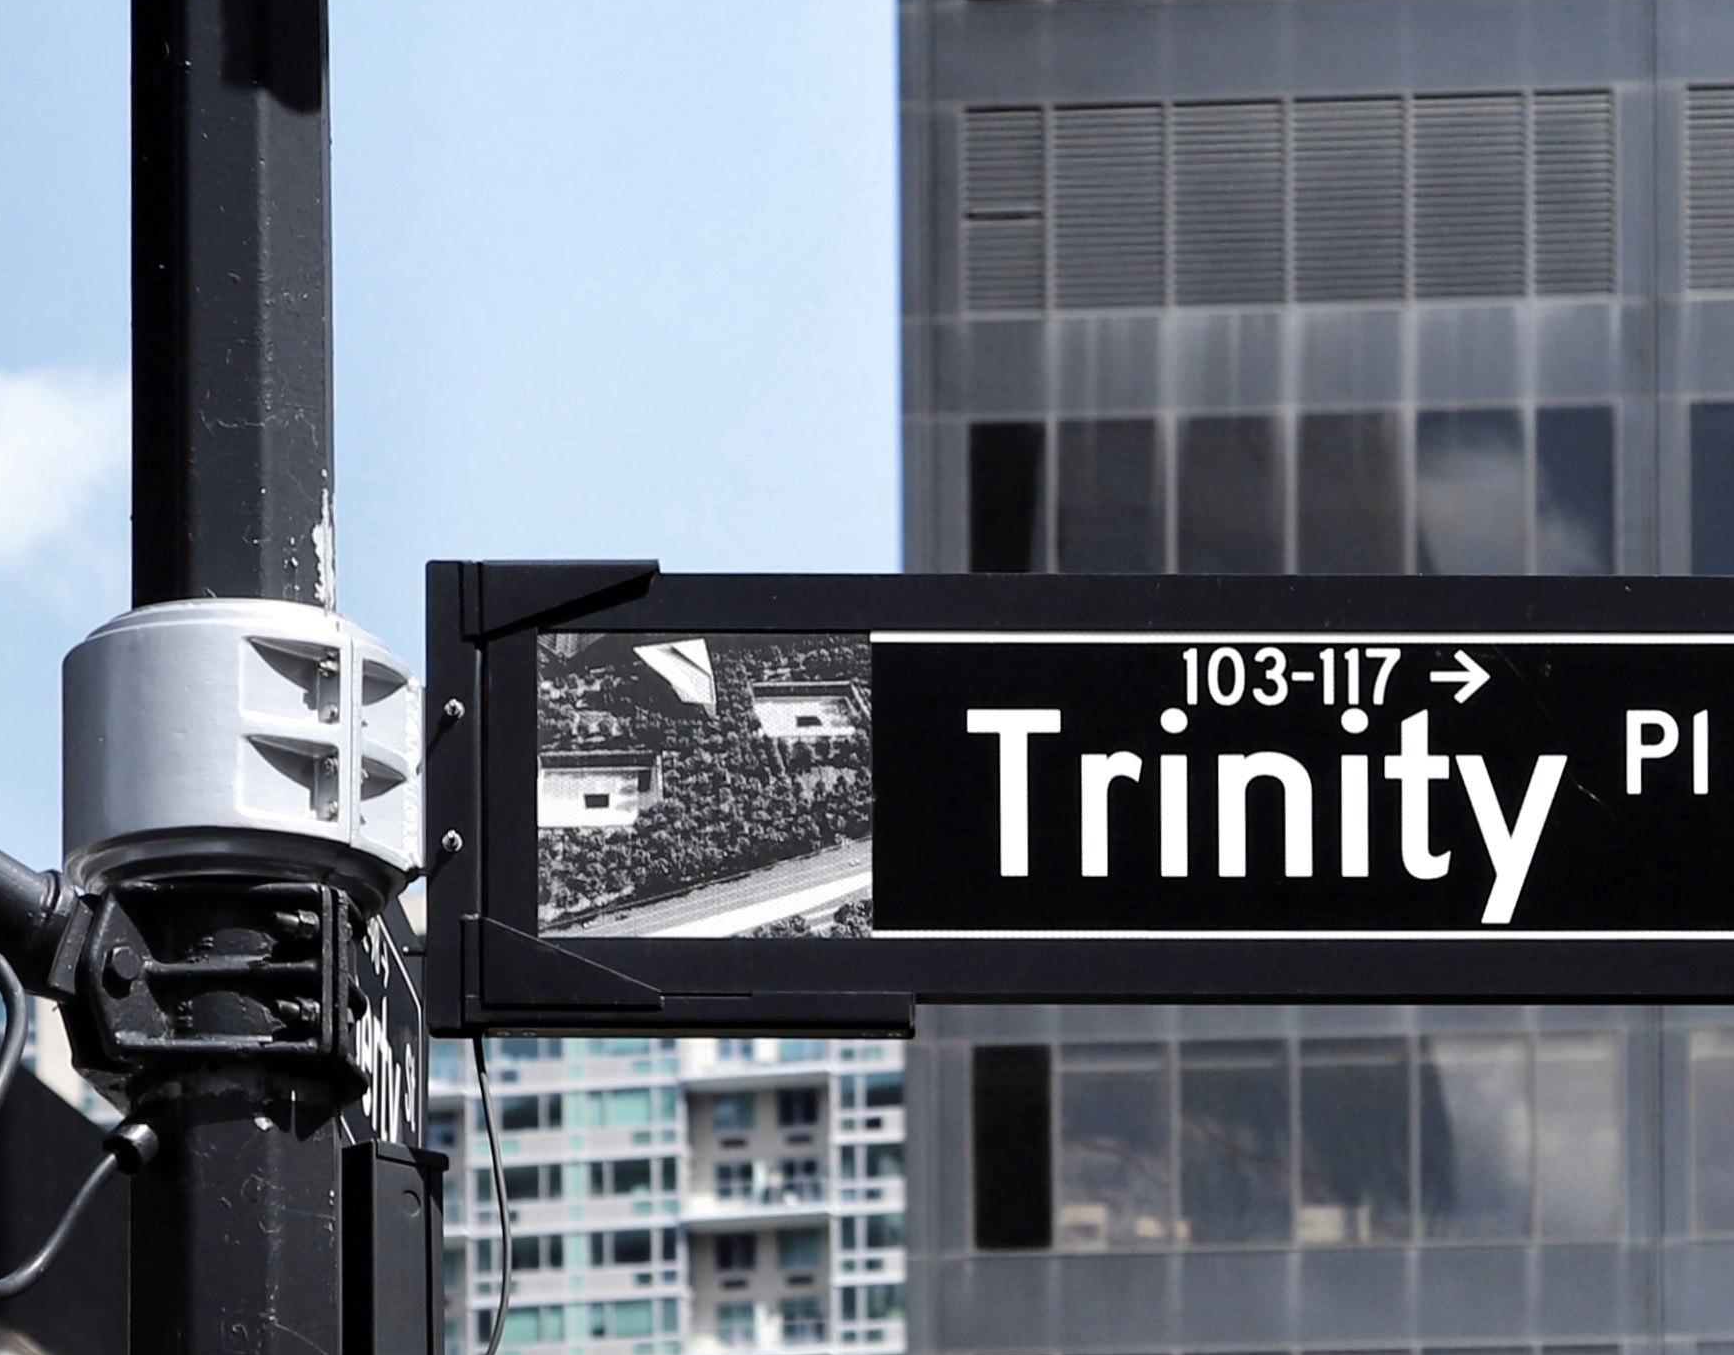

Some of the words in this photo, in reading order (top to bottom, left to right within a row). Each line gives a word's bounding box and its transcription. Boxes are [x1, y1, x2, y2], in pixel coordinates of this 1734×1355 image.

[1182, 646, 1402, 706] 103-117
[966, 707, 1569, 925] Trinity
[1625, 708, 1710, 796] Pl
